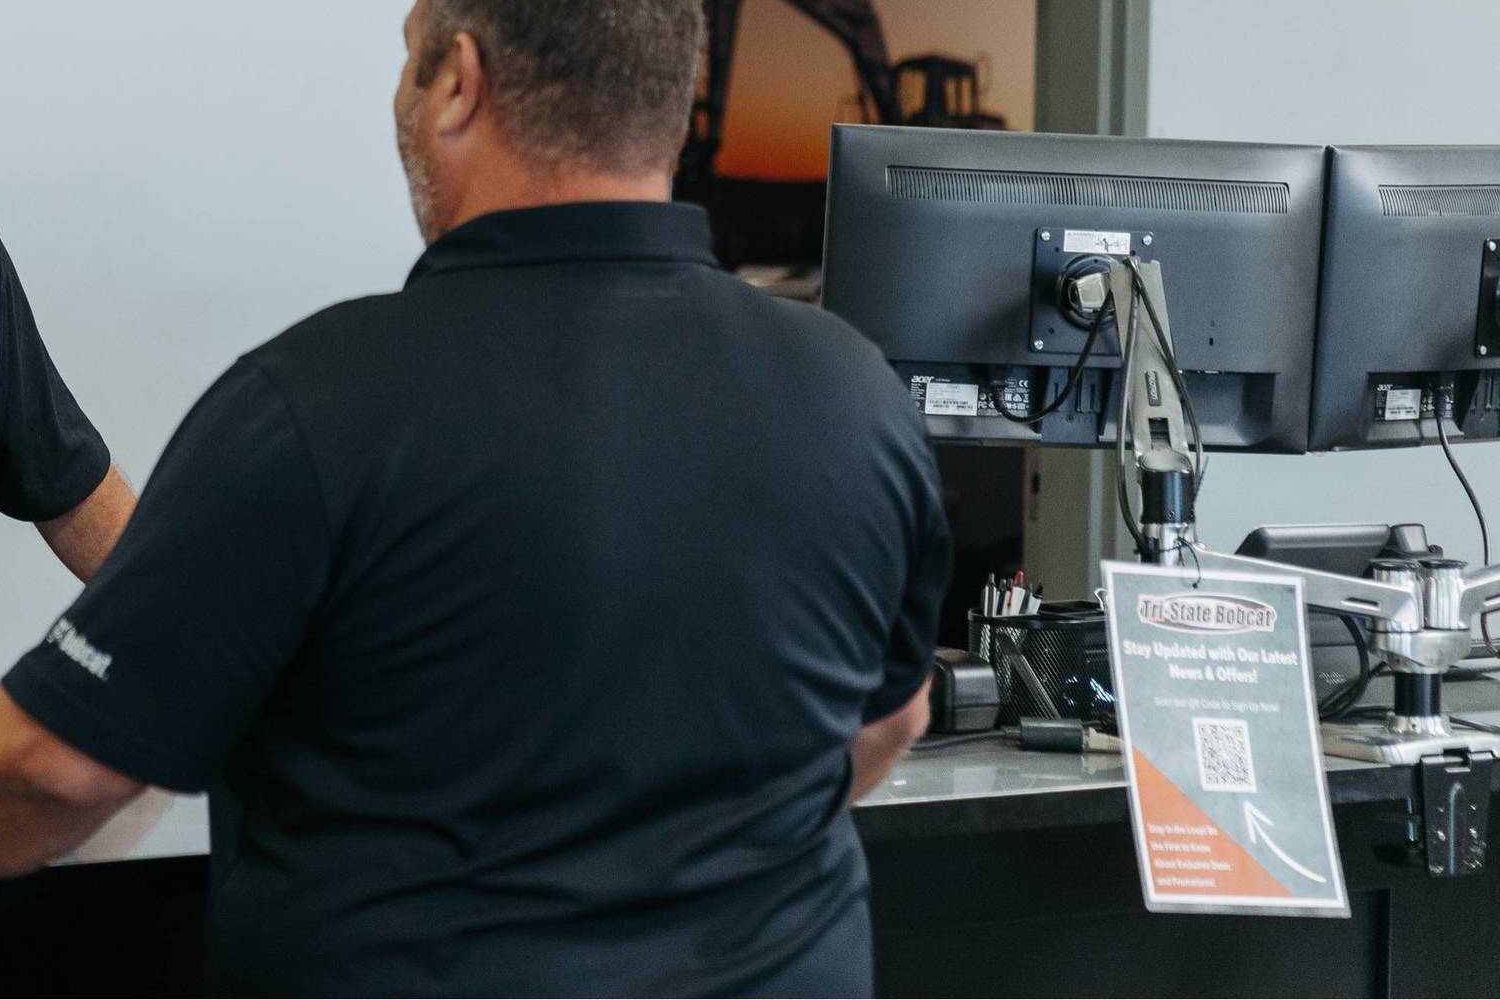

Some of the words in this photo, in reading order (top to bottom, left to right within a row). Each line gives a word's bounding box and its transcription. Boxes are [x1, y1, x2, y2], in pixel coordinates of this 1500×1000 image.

[910, 375, 935, 384] acer
[1139, 599, 1213, 624] Tri-State
[1216, 604, 1273, 628] Bobcat
[1123, 638, 1151, 660] Stay
[1152, 641, 1206, 661] Updated
[1208, 645, 1236, 662] with
[1237, 648, 1259, 663] Our
[1261, 649, 1298, 666] Latest
[1168, 663, 1203, 681] News
[1204, 664, 1215, 681] &
